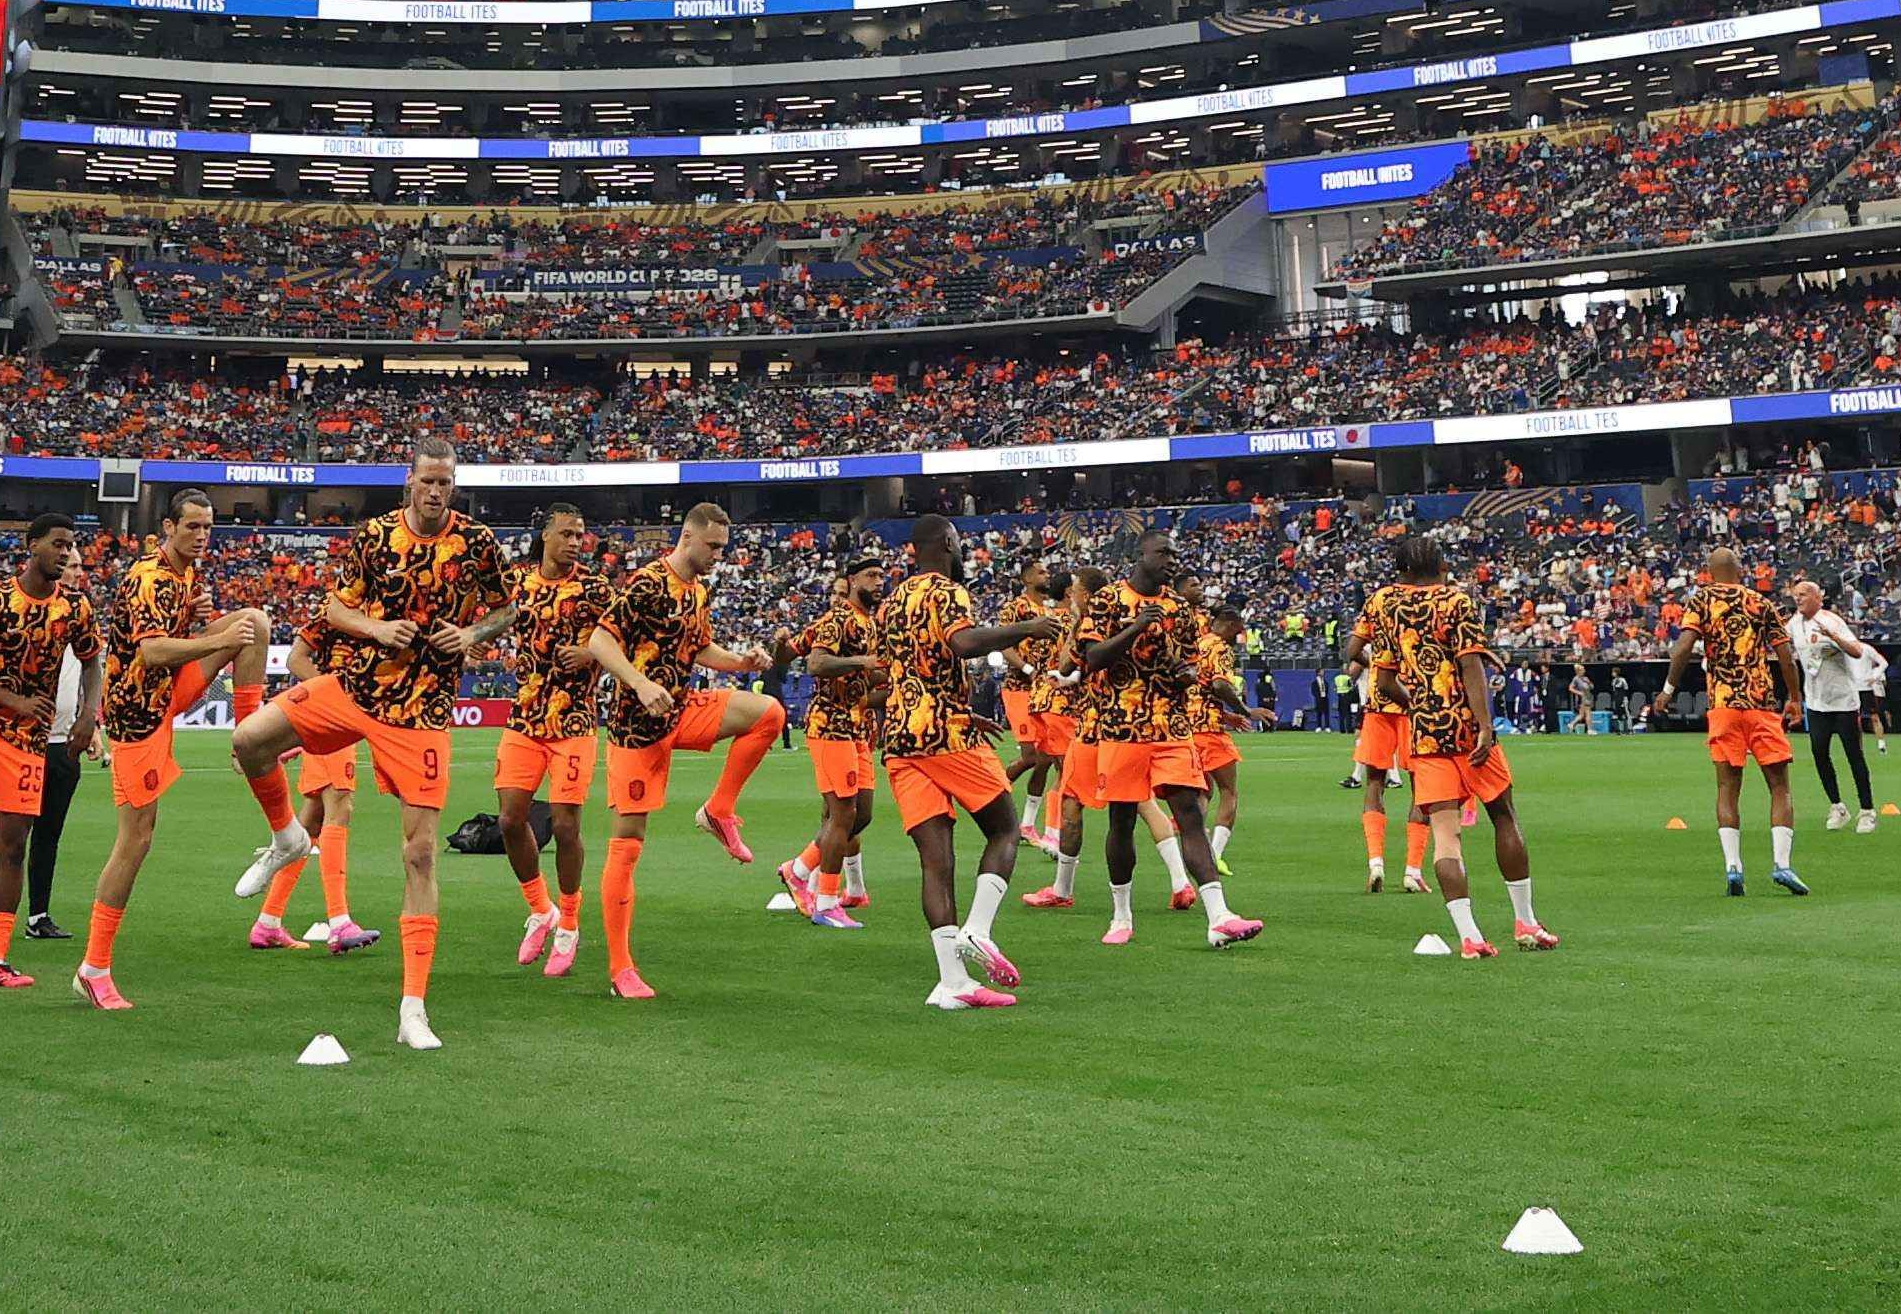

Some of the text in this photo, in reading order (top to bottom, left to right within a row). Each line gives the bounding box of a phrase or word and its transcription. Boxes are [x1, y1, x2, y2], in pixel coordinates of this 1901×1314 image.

[406, 5, 466, 22] FOOTBALL
[675, 0, 735, 16] FOOTBALL
[1647, 23, 1704, 49] FOOTBALL
[1414, 62, 1466, 84] FOOTBALL
[1198, 90, 1245, 113] FOOTBALL
[986, 117, 1035, 136] FOOTBALL
[94, 127, 146, 146] FOOTBALL
[771, 132, 818, 149] FOOTBALL
[324, 137, 373, 157] FOOTBALL
[549, 141, 599, 157] FOOTBALL
[1322, 169, 1376, 189] FOOTBALL
[534, 270, 568, 285] FIFA
[569, 269, 627, 284] WORLD
[1526, 410, 1618, 433] FOOTBALL TES
[1250, 430, 1335, 452] FOOTBALL TES
[1000, 447, 1076, 465] FOOTBALL TES
[227, 464, 314, 482] FOOTBALL TES
[500, 465, 584, 482] FOOTBALL TES
[761, 460, 839, 478] FOOTBALL TES
[423, 748, 438, 781] 9
[567, 755, 580, 782] 5
